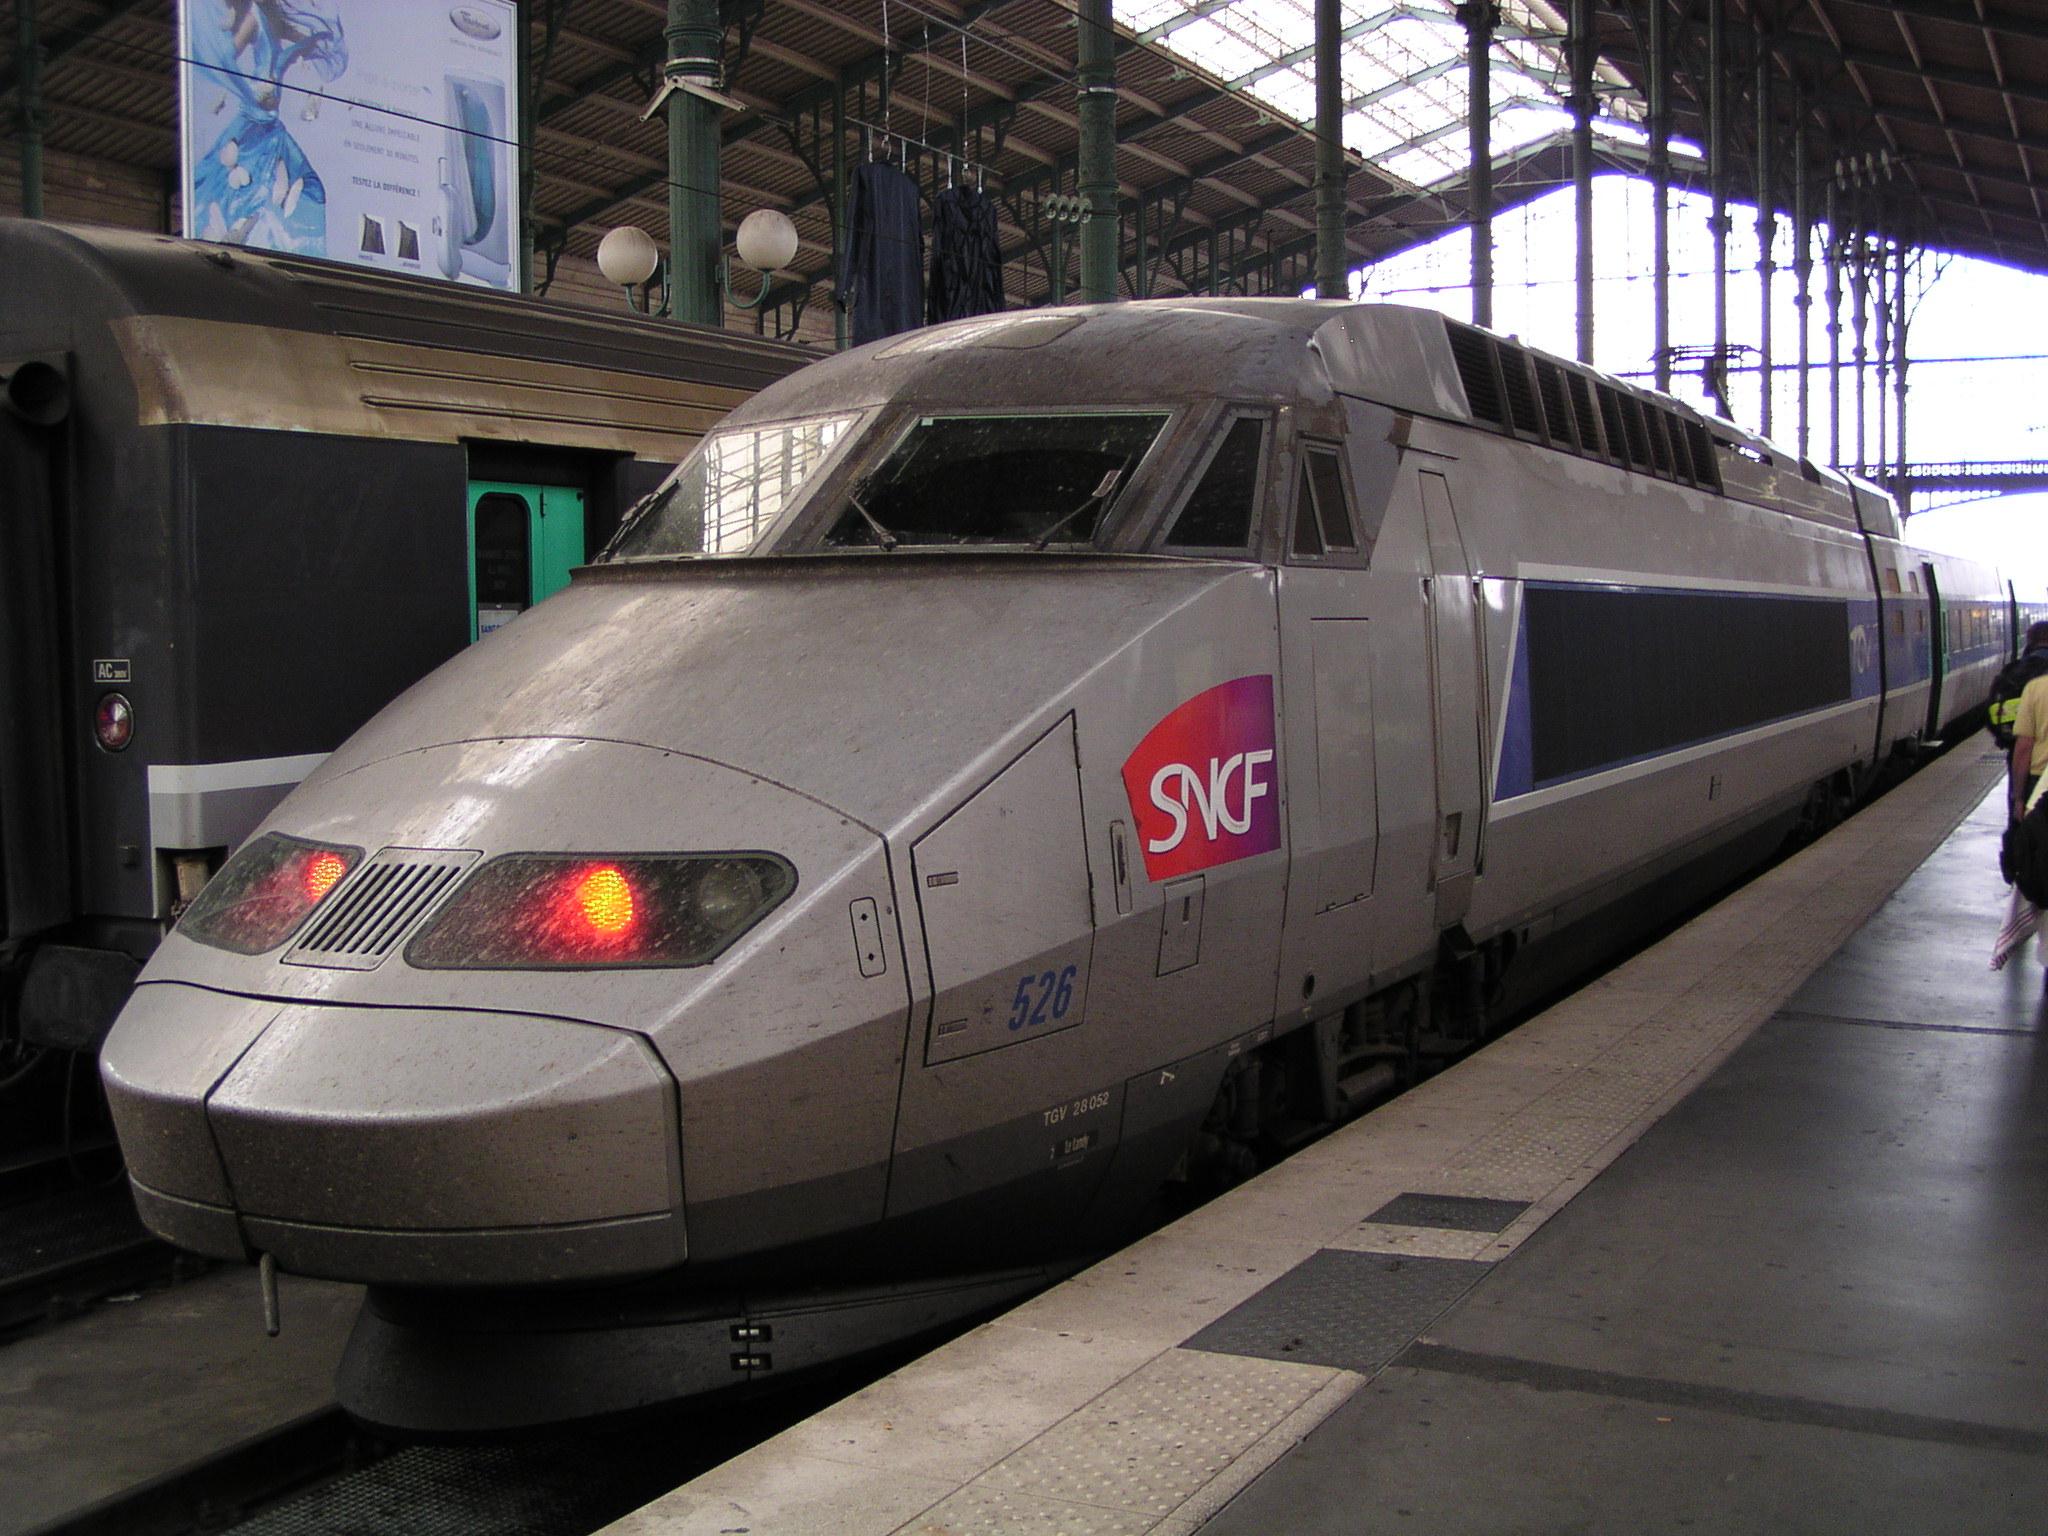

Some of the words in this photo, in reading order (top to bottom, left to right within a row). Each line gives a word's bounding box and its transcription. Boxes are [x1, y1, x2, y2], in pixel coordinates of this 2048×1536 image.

[352, 176, 372, 188] TESTEZ
[374, 180, 381, 189] LA
[94, 667, 107, 686] AC
[1147, 748, 1274, 854] SNCF
[1008, 964, 1078, 1031] 526
[1043, 1104, 1067, 1127] TGV
